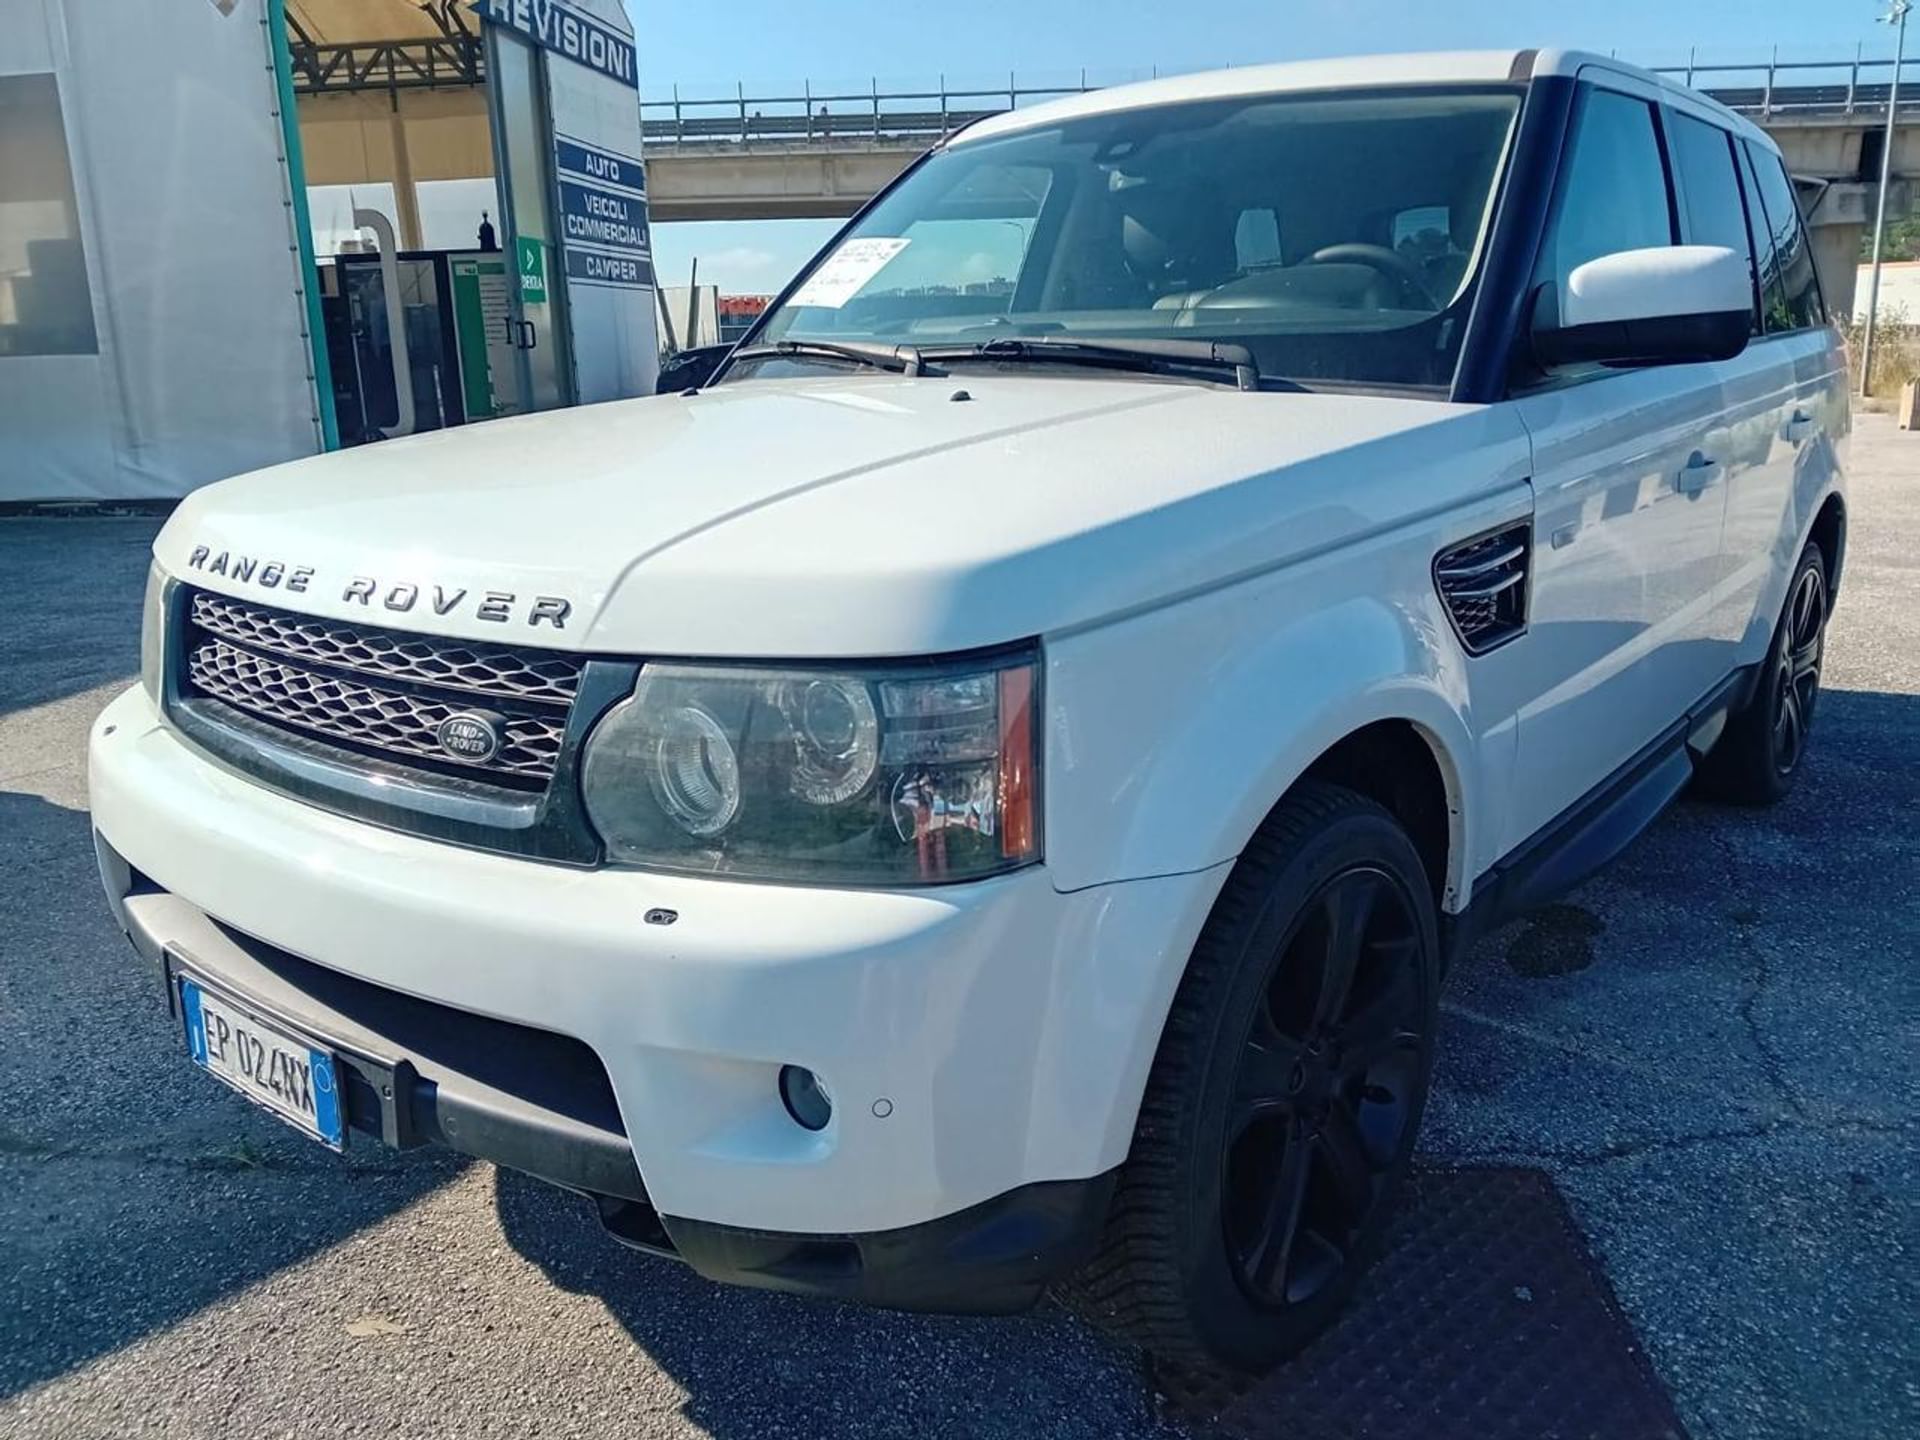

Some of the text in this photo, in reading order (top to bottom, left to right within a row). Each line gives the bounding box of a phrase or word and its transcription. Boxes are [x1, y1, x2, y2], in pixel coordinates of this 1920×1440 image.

[586, 153, 620, 181] AUTO
[583, 192, 628, 221] VEICOLI
[567, 214, 647, 246] COMMERCIALI
[586, 256, 637, 281] CAMPER
[188, 544, 573, 629] RANGE ROVER
[449, 723, 478, 739] LAND
[450, 736, 486, 754] ROVER
[203, 1007, 231, 1063] EP
